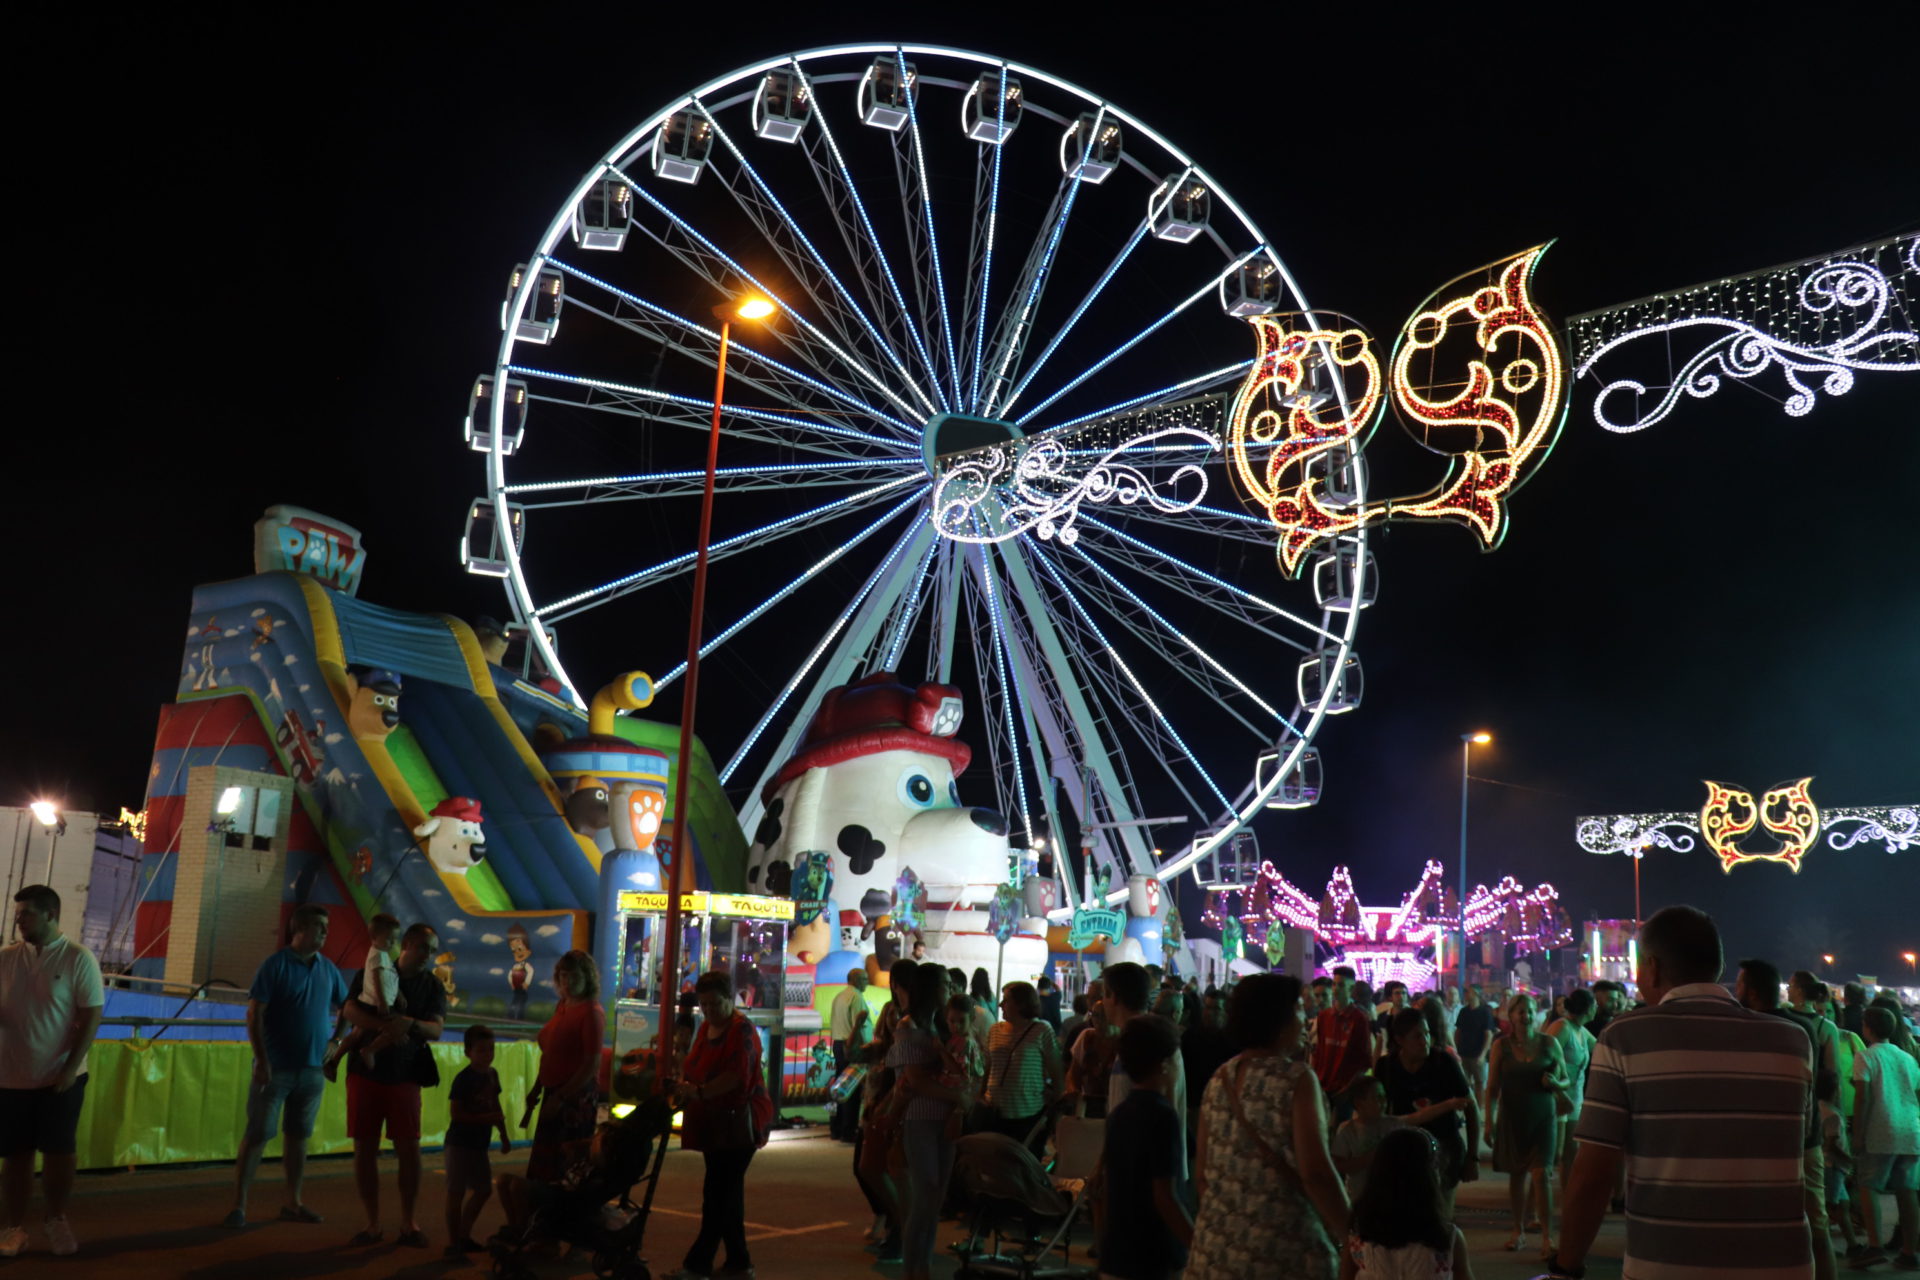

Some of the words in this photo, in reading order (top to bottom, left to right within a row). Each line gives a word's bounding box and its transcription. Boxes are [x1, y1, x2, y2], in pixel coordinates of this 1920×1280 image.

[278, 526, 361, 588] PAW
[635, 896, 692, 908] TAQUA
[1080, 916, 1117, 934] ENTRADA
